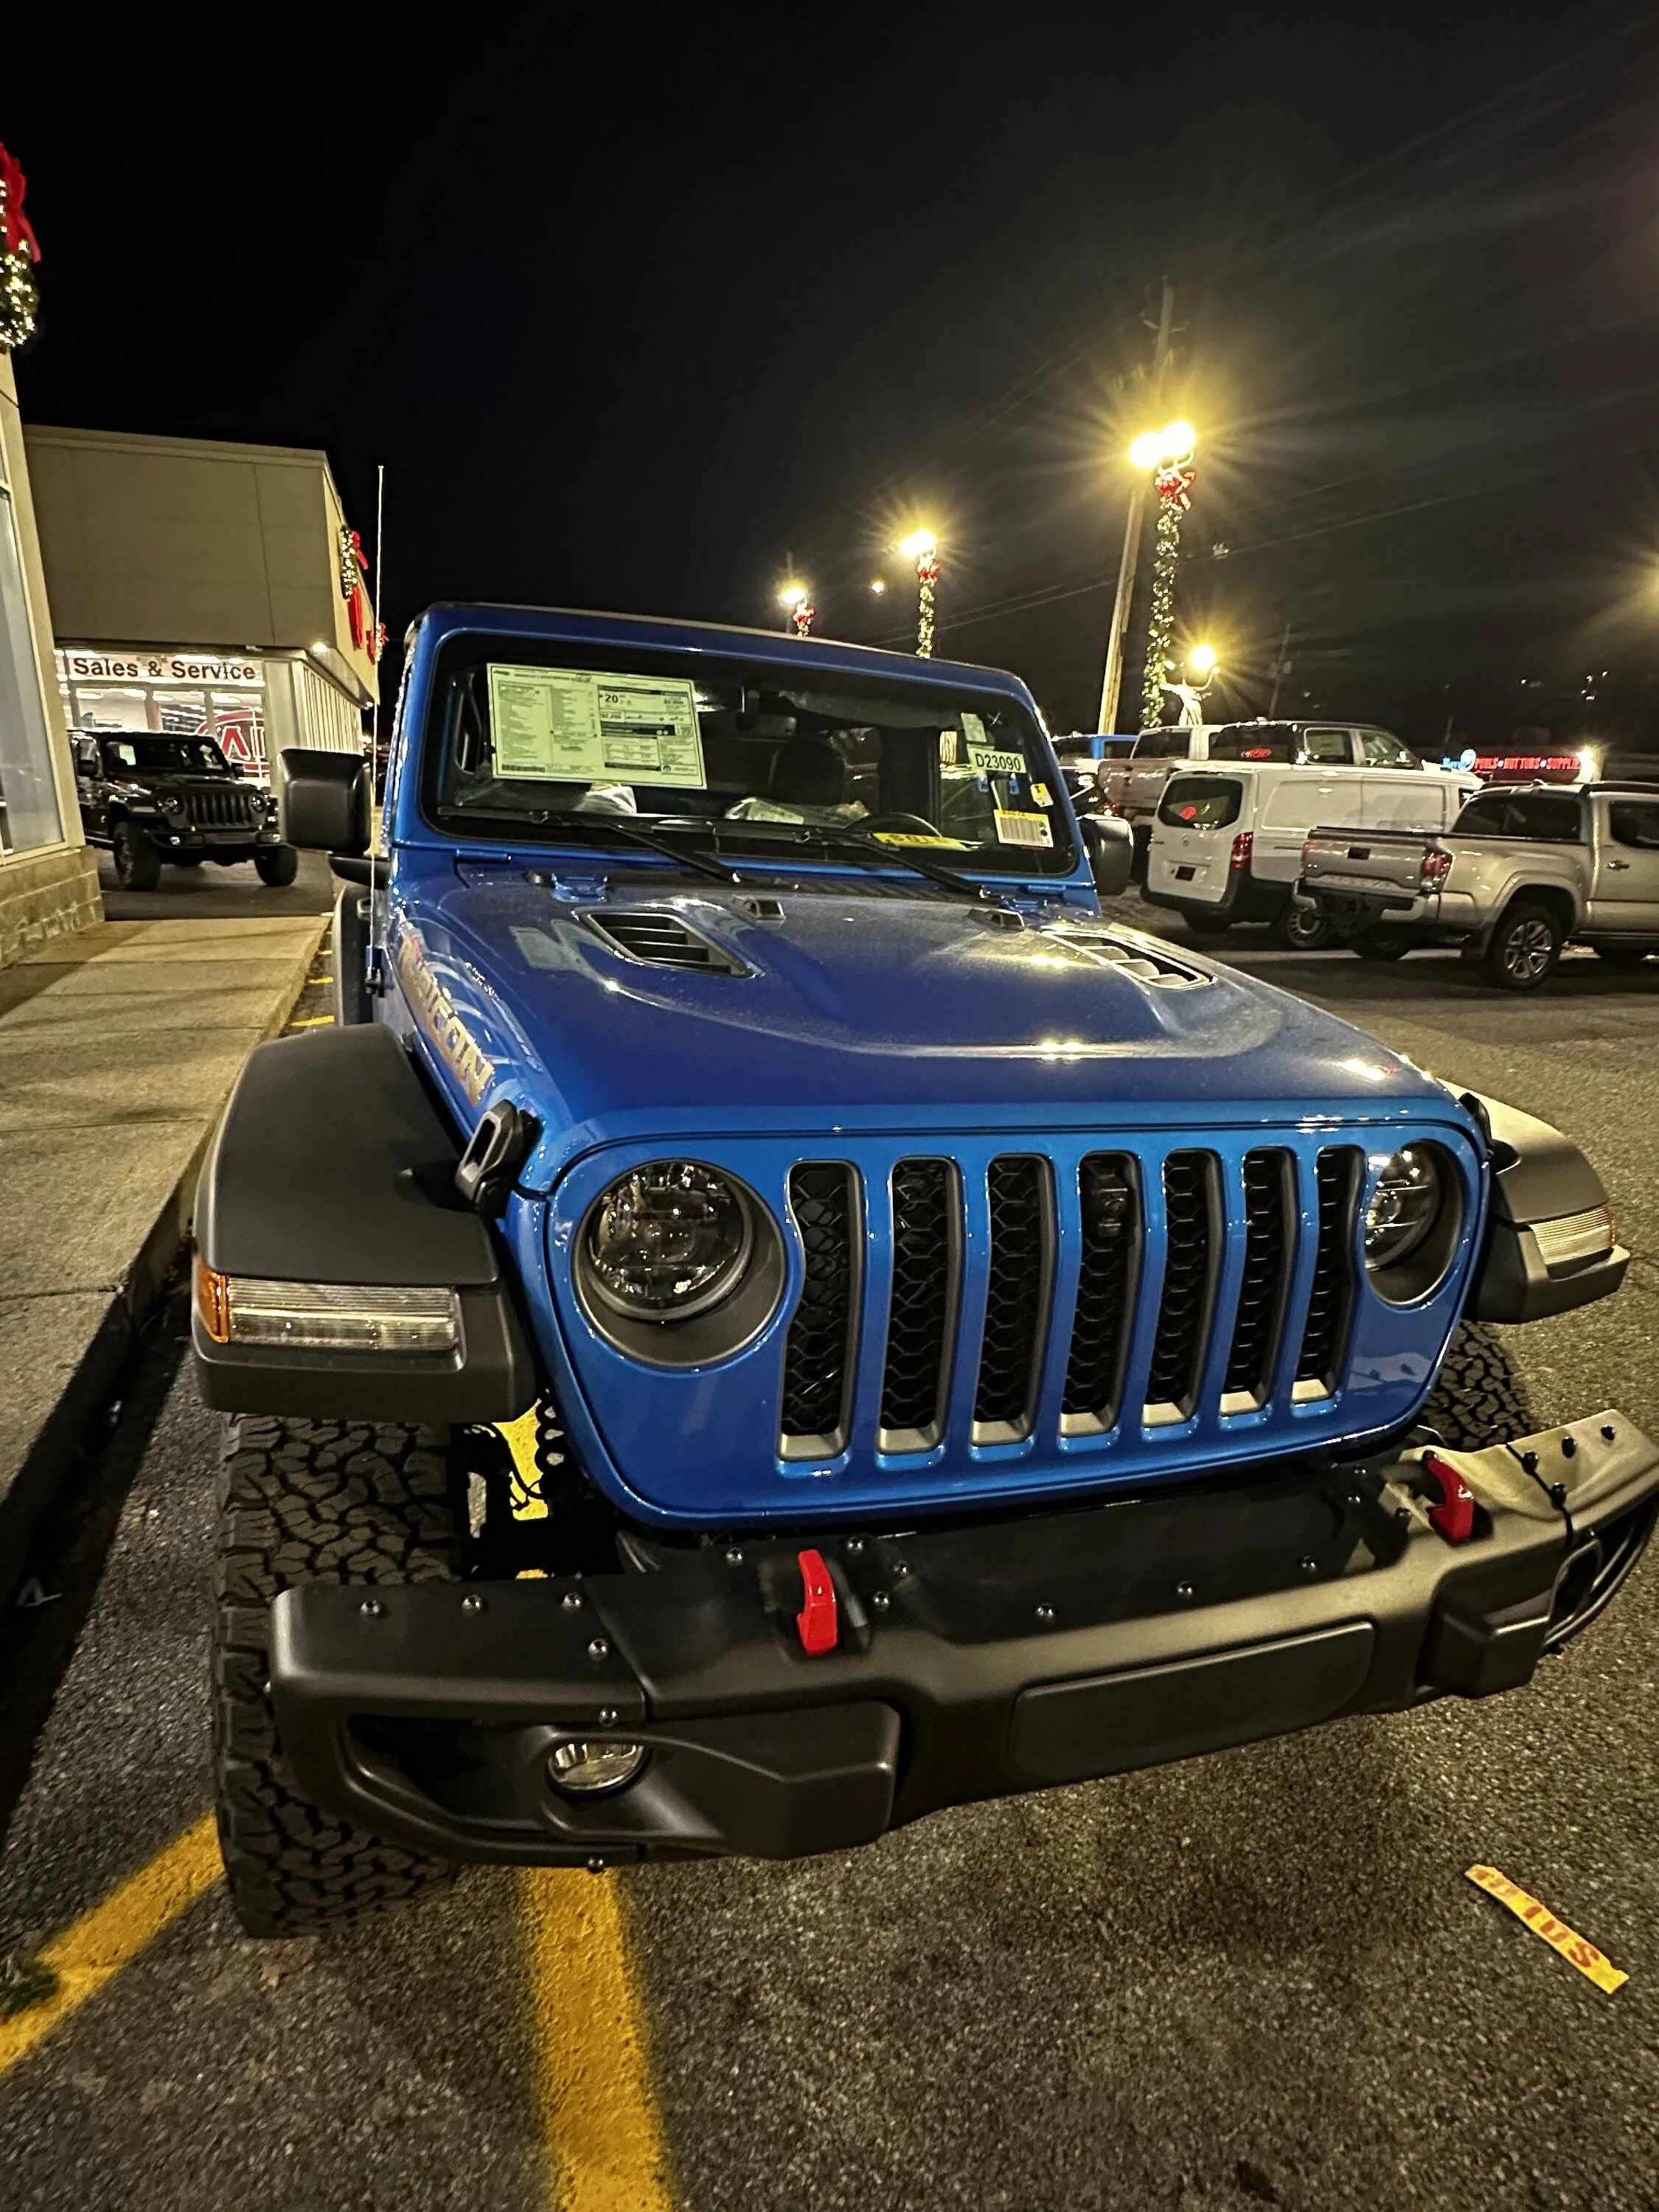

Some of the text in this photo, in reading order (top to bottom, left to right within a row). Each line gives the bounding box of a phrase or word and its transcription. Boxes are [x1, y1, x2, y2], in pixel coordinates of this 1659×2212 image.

[74, 657, 256, 680] Sales & Service
[605, 693, 619, 703] 20
[975, 753, 1021, 771] D23090
